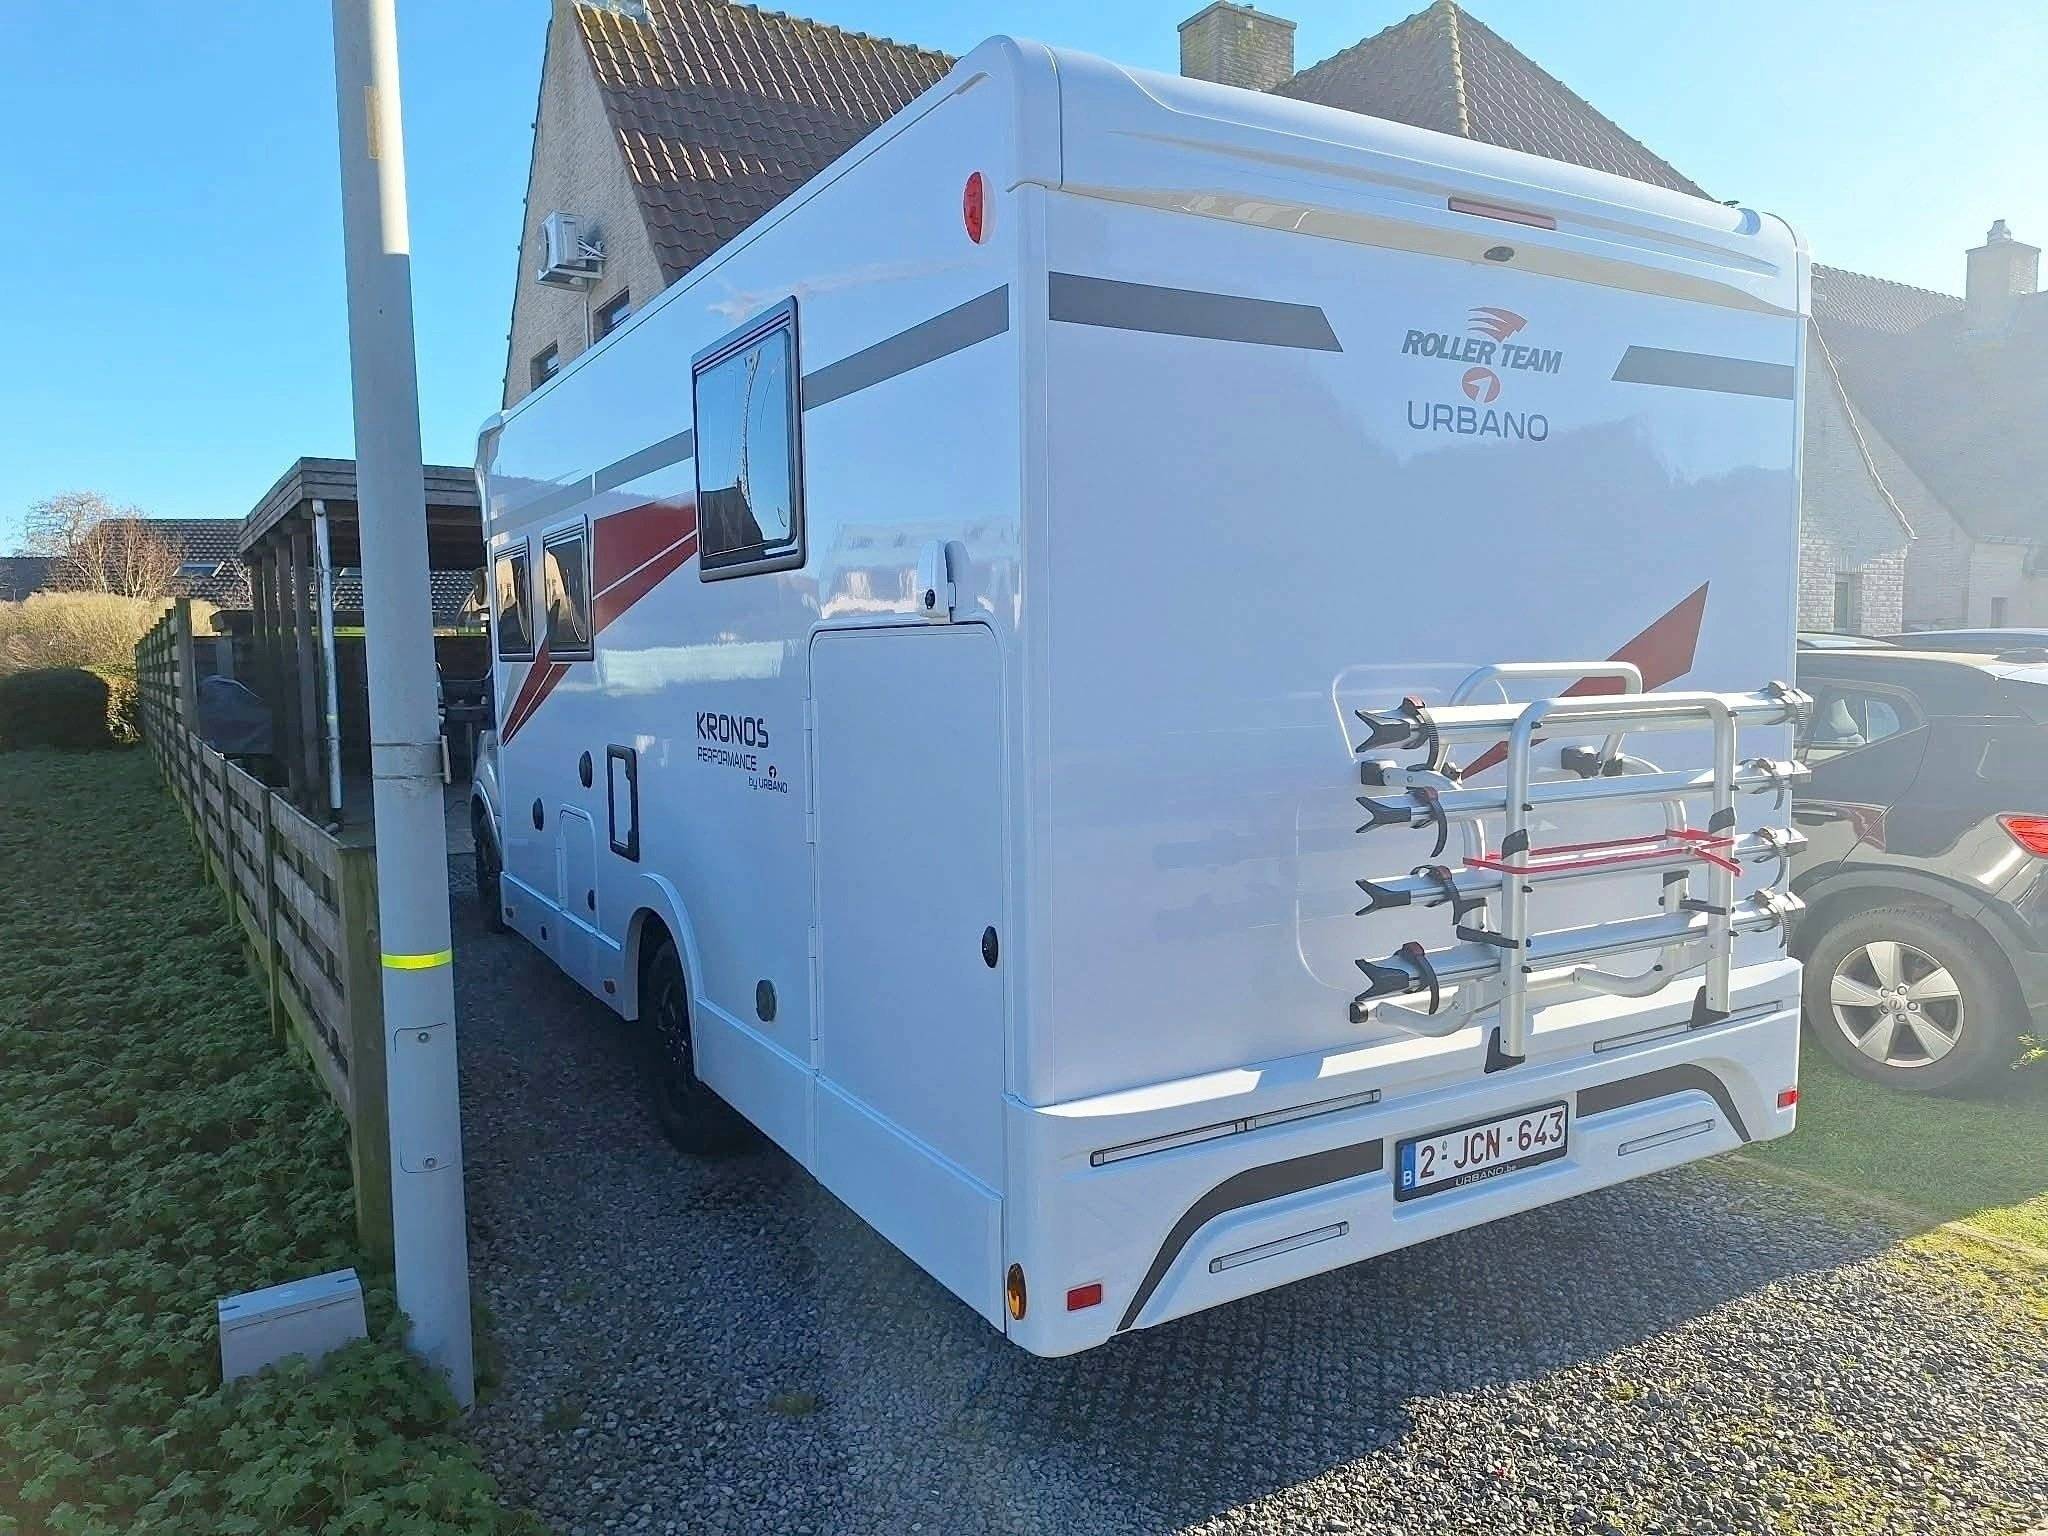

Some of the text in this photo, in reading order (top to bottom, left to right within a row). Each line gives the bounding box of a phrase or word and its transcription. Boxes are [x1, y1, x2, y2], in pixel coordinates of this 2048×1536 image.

[1401, 329, 1563, 374] ROLLER TEAM
[1407, 400, 1549, 442] URBANO
[696, 711, 769, 749] KRONOS
[697, 746, 757, 772] PERFORMANCE
[748, 776, 788, 794] by URBANO
[1403, 1170, 1412, 1186] B
[1454, 1164, 1517, 1187] URBANO.be
